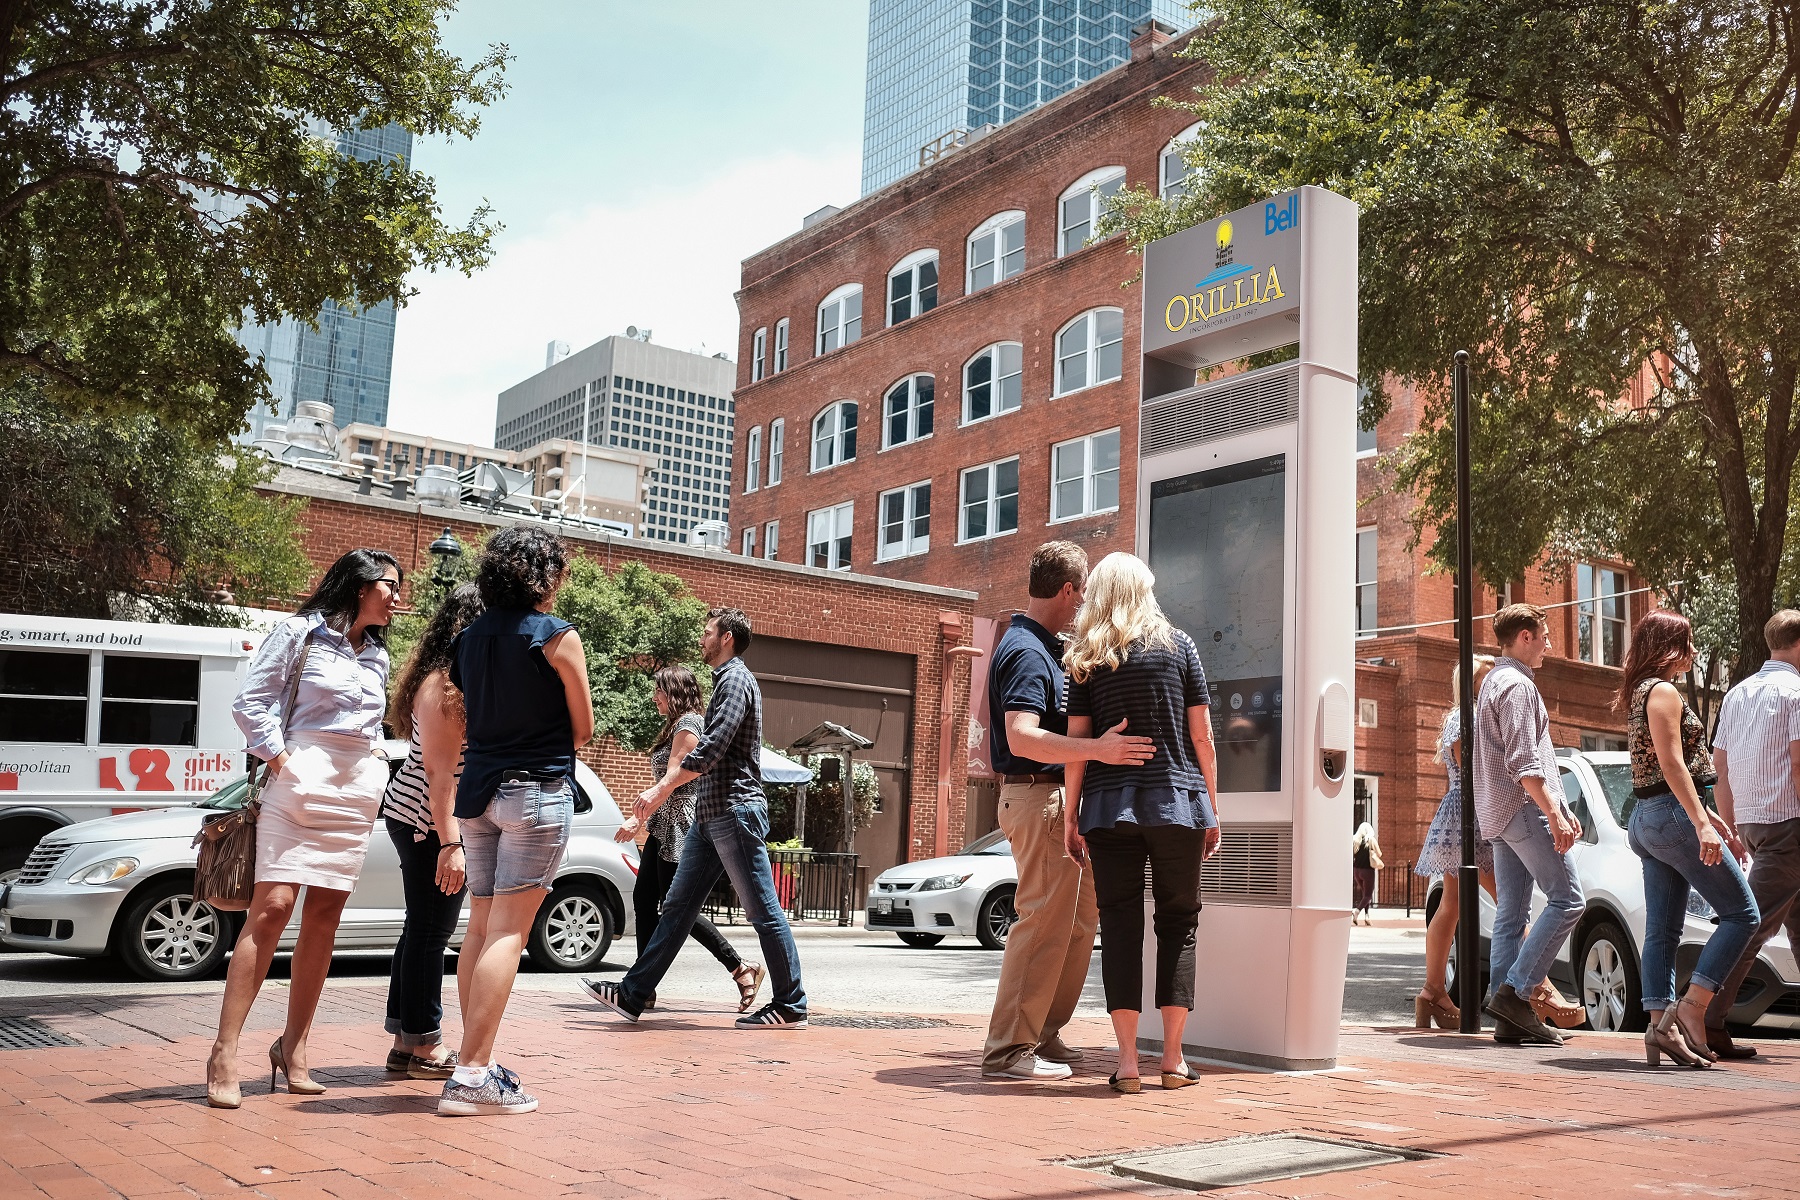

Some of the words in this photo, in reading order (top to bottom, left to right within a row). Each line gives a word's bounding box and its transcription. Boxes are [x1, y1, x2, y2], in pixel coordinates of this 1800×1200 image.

[1265, 194, 1298, 236] Bell
[1165, 264, 1286, 332] ORILLIA
[1189, 313, 1241, 334] INCORPORATED
[19, 630, 70, 644] smart,
[75, 632, 105, 644] and
[109, 633, 143, 646] bold
[185, 752, 231, 777] girls
[184, 773, 220, 791] inc.
